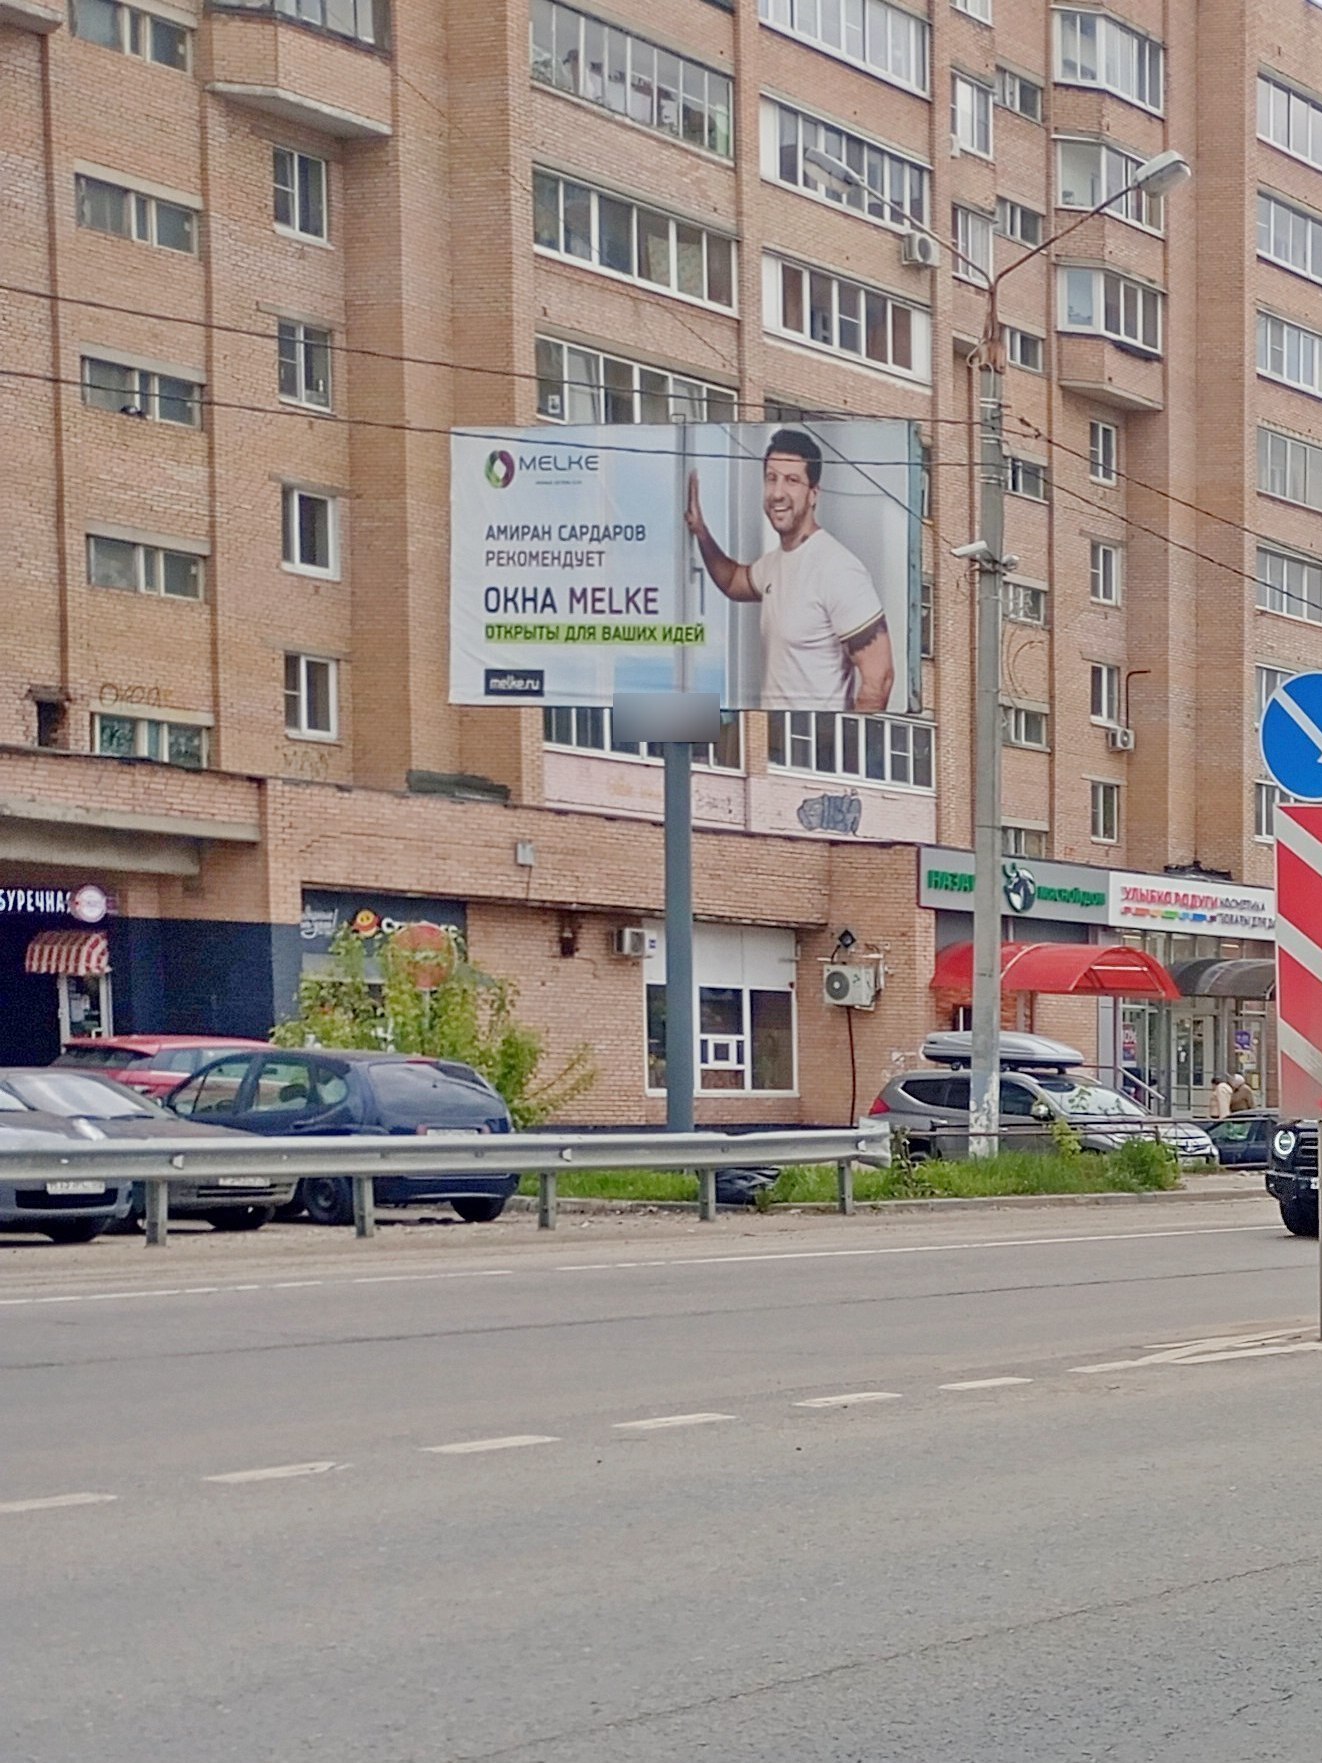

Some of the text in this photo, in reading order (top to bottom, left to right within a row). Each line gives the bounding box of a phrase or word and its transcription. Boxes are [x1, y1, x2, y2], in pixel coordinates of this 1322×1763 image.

[519, 455, 600, 471] MELKE
[485, 525, 646, 543] АМИРАН САРДАРОВ
[485, 551, 606, 569] РЕКОМЕНДУЕТ
[484, 587, 659, 615] ОКНА MELKE
[485, 624, 705, 643] ОТКРЫТЫ ДЛЯ ВАШИХ ИДЕЙ
[489, 674, 540, 690] melke.ru
